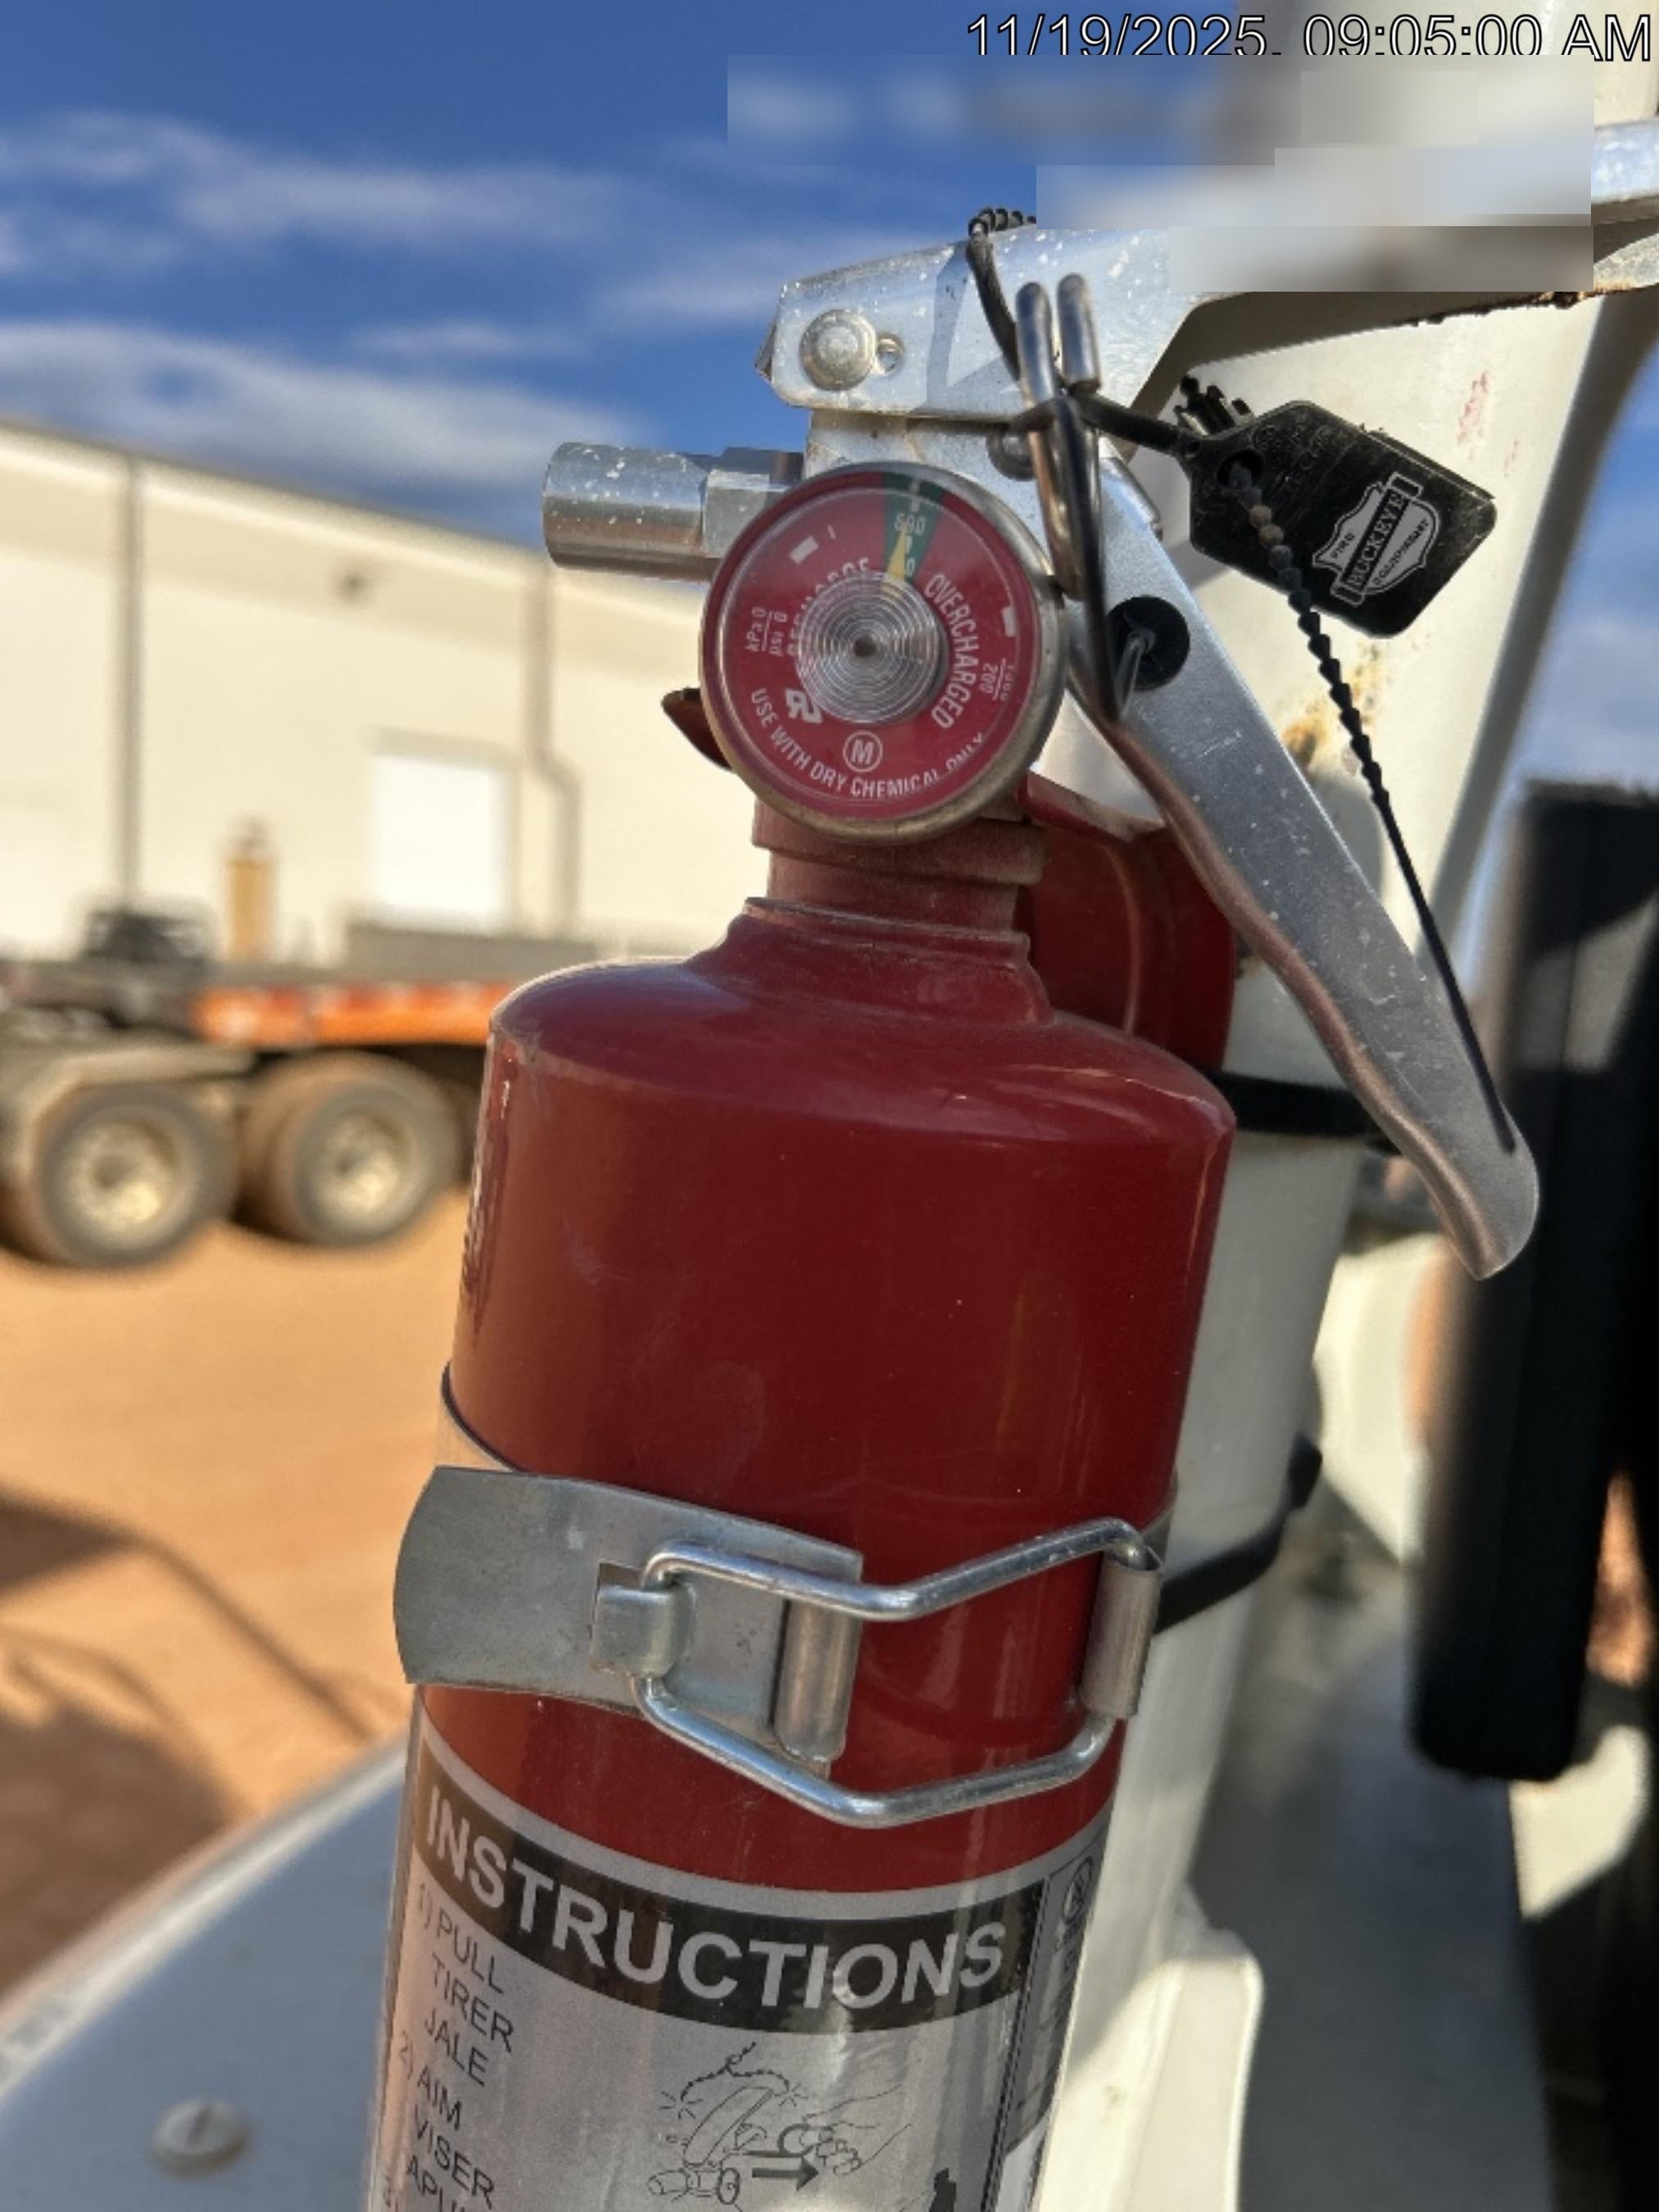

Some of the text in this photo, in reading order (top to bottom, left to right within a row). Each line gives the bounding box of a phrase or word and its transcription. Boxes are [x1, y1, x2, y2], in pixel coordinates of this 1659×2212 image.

[923, 573, 980, 729] OVERCHARGED
[751, 687, 778, 728] USE
[769, 725, 813, 771] WITH
[809, 762, 849, 793] DRY
[850, 767, 941, 799] CHEMICAL
[424, 1785, 1007, 2010] INSTRUCTIONS
[432, 1951, 515, 2053] TIRER
[437, 1907, 505, 1995] PULL
[418, 2065, 462, 2132] AIM
[424, 2009, 489, 2087] JALE
[414, 2103, 495, 2210] VISER
